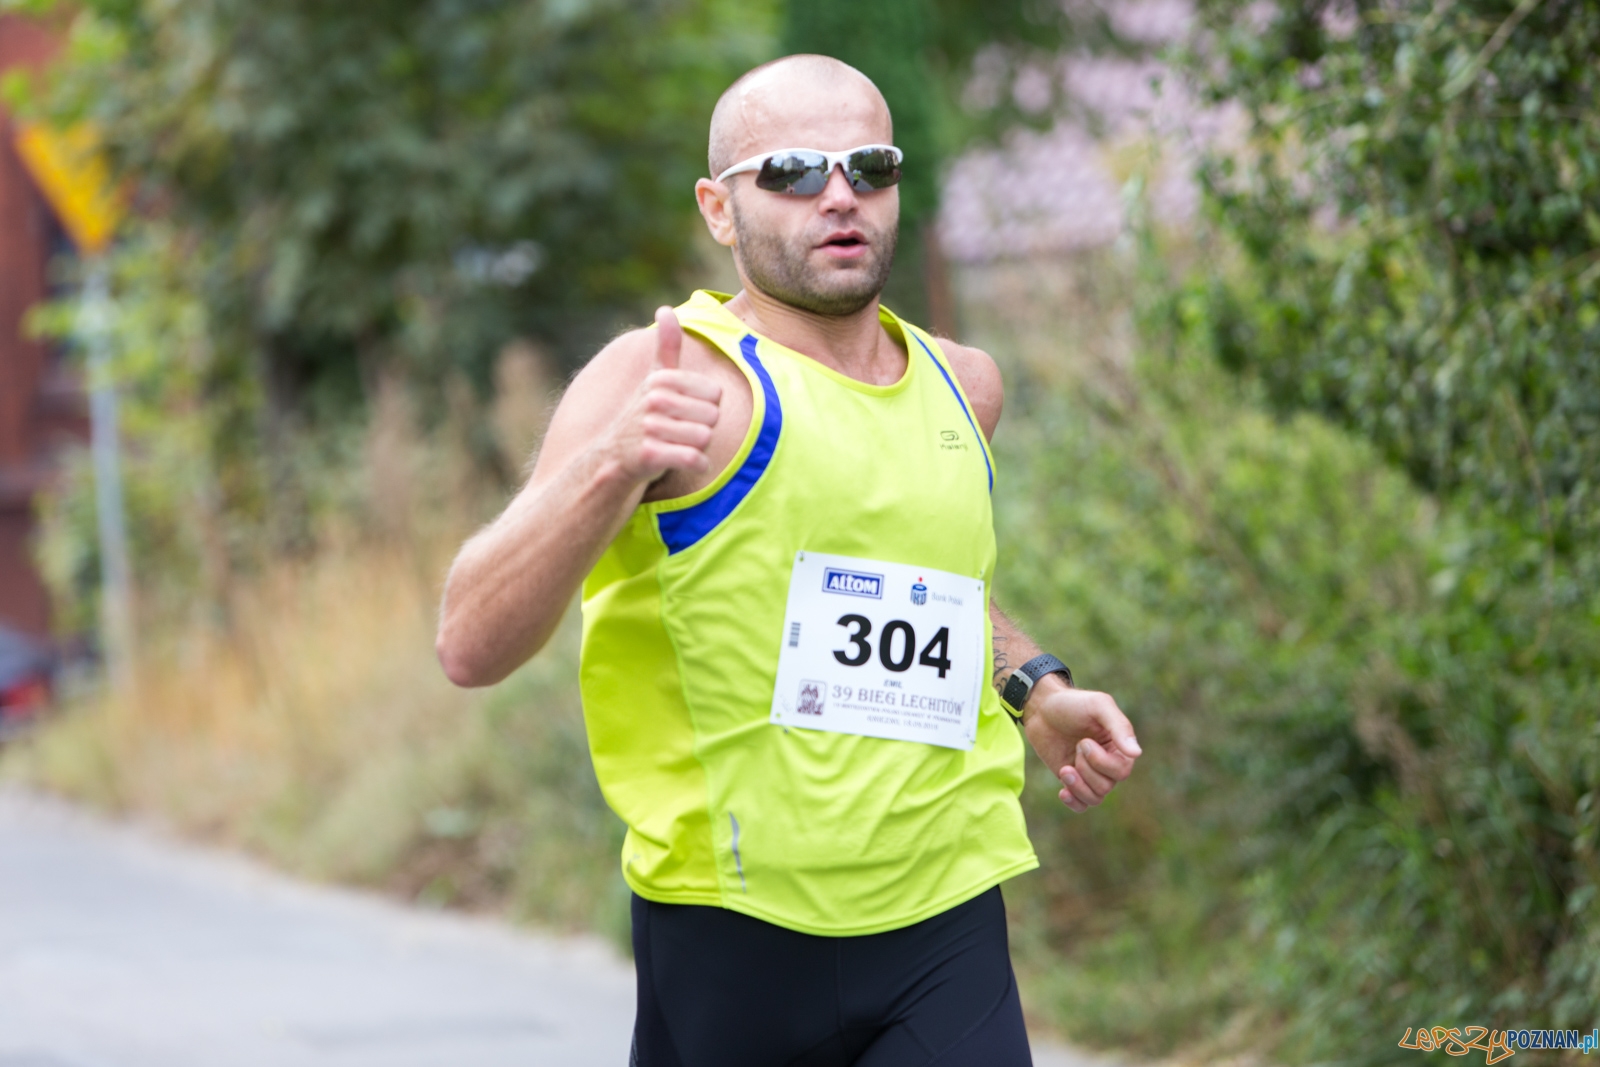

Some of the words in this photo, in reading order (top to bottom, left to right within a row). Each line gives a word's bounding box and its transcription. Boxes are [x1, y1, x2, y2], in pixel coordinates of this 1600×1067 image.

[833, 614, 951, 679] 304
[883, 679, 903, 689] EMIL
[832, 685, 853, 700] 39
[858, 688, 896, 706] BIEG
[901, 694, 965, 716] LECHITÓW
